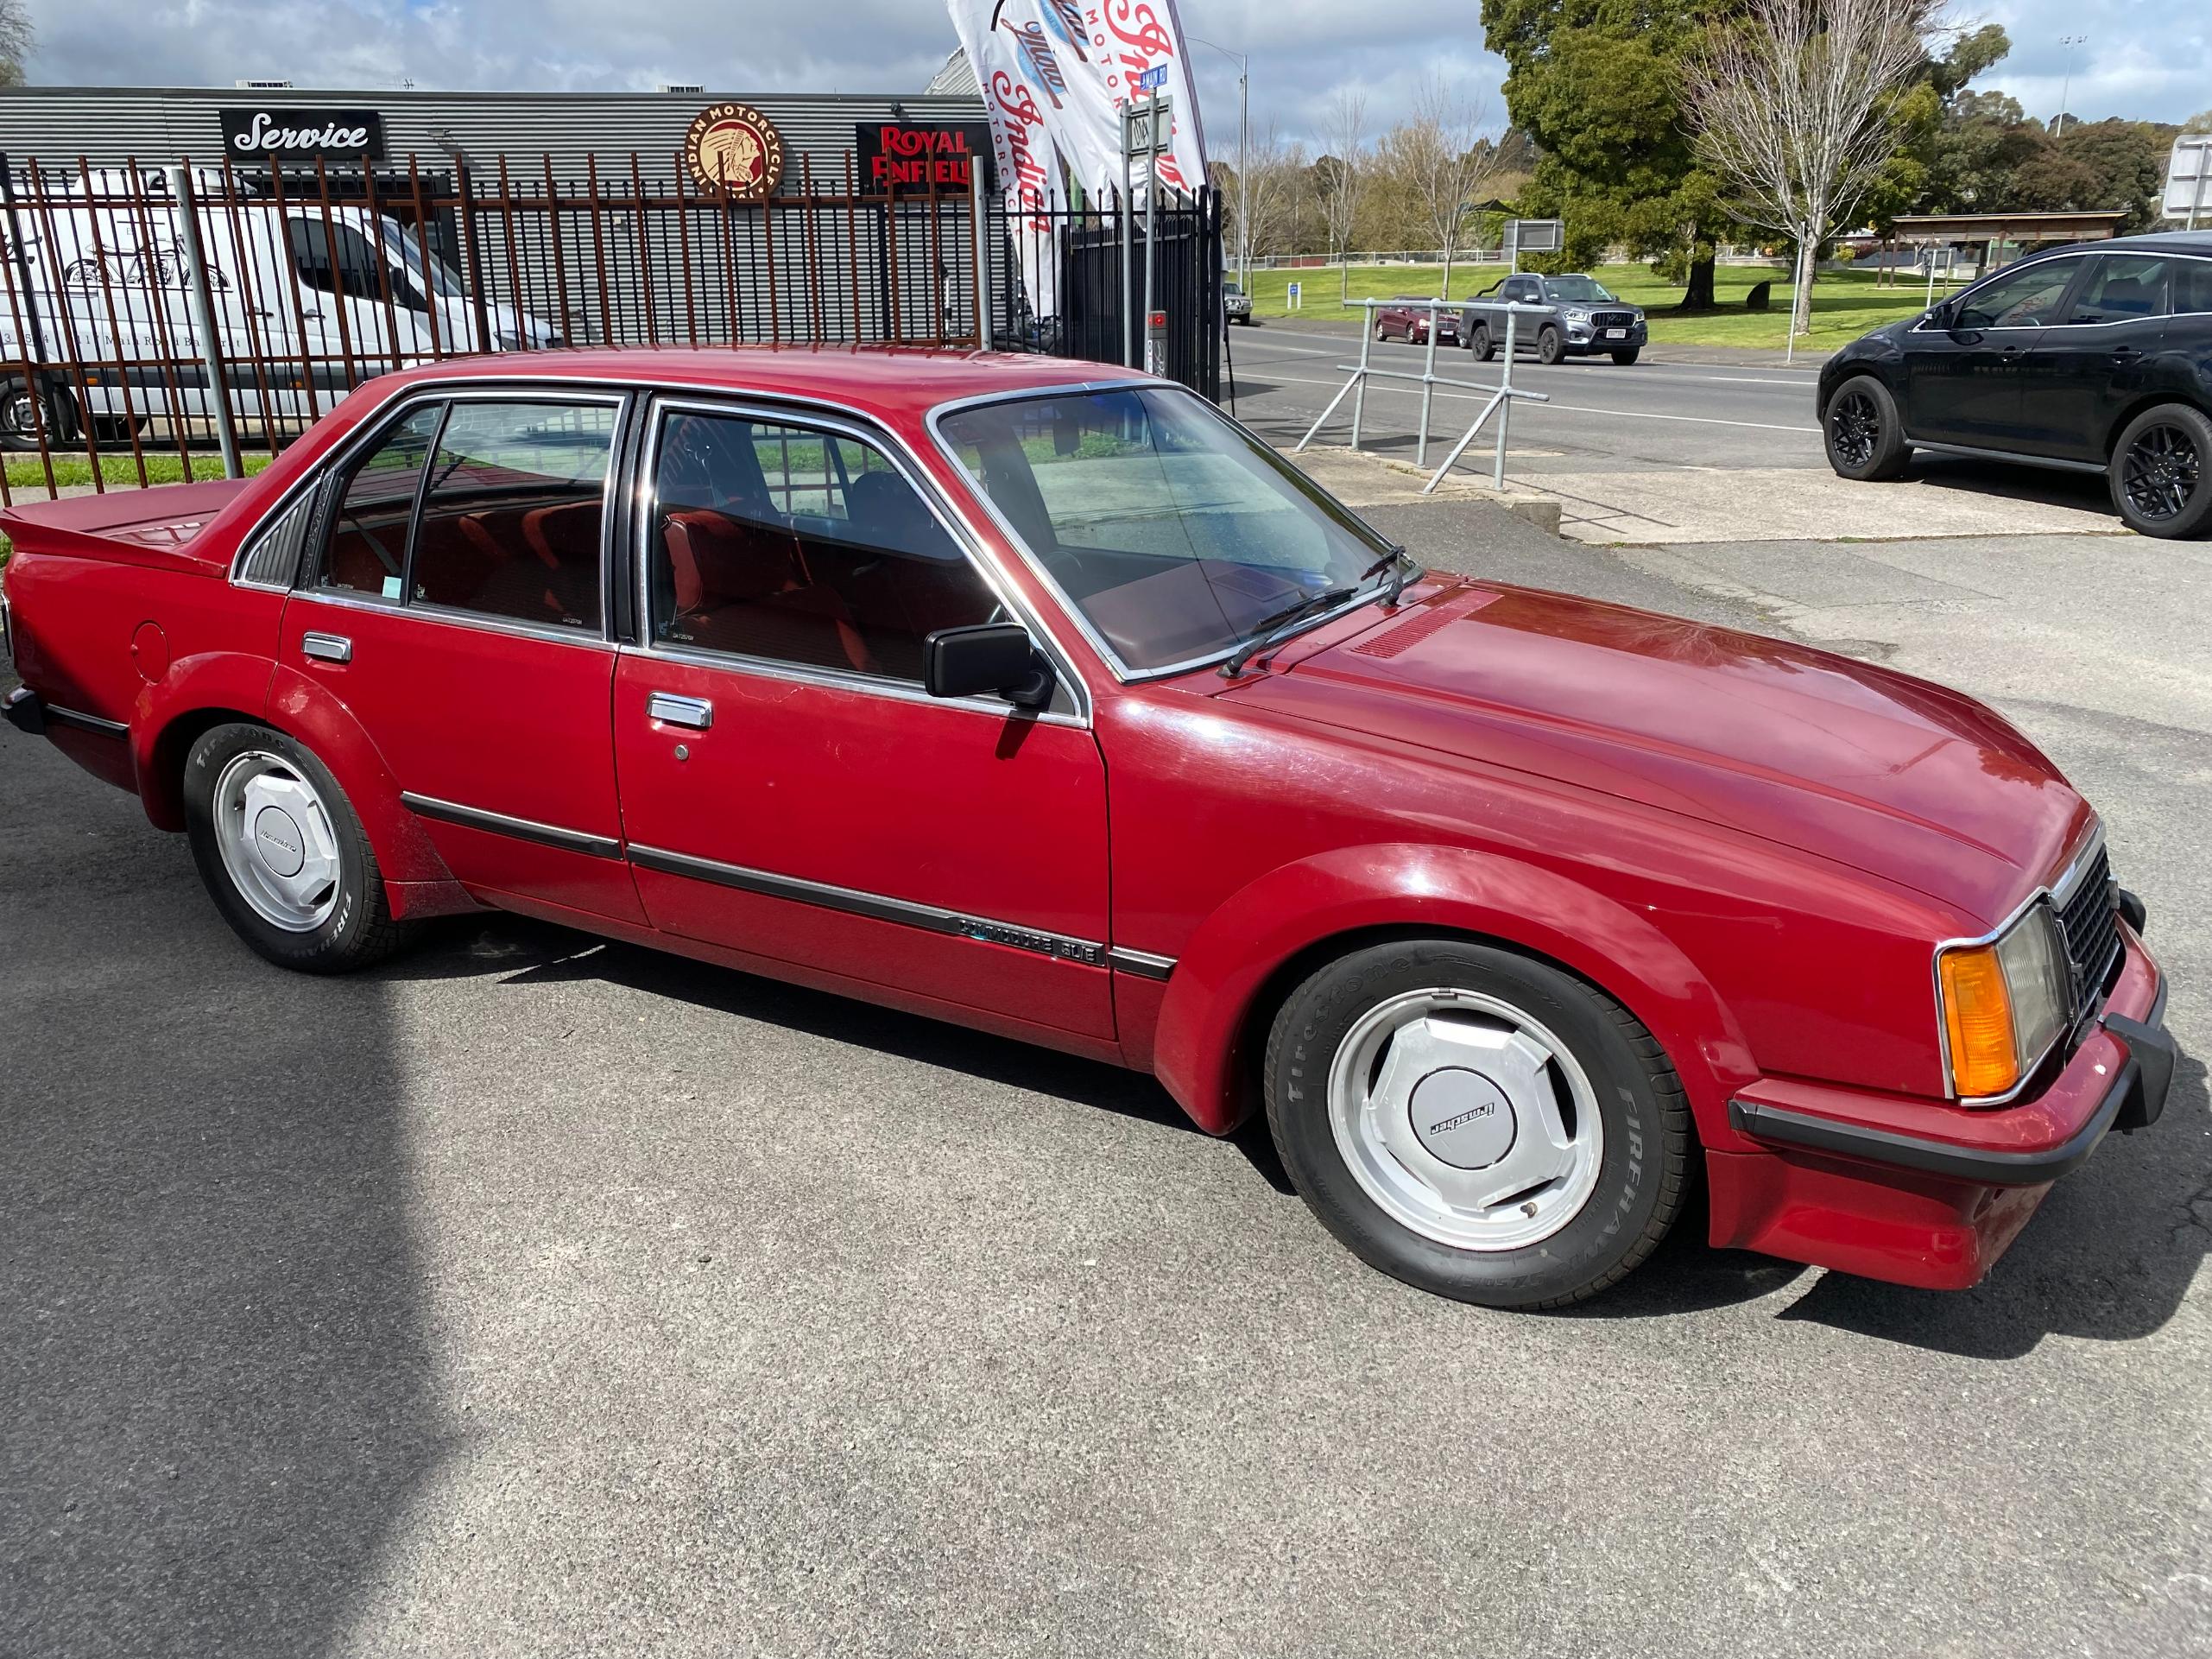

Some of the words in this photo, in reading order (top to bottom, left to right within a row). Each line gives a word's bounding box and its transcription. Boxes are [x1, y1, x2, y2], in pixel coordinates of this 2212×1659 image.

[1146, 69, 1158, 85] MAIN
[1159, 66, 1166, 84] RD
[234, 112, 369, 151] Service
[687, 118, 707, 186] INDIAN
[709, 105, 781, 186] MOTORCYCLE
[881, 126, 968, 156] ROYAL
[992, 71, 1051, 234] Indian
[144, 336, 180, 346] Rod
[1430, 1101, 1495, 1136] irmscher
